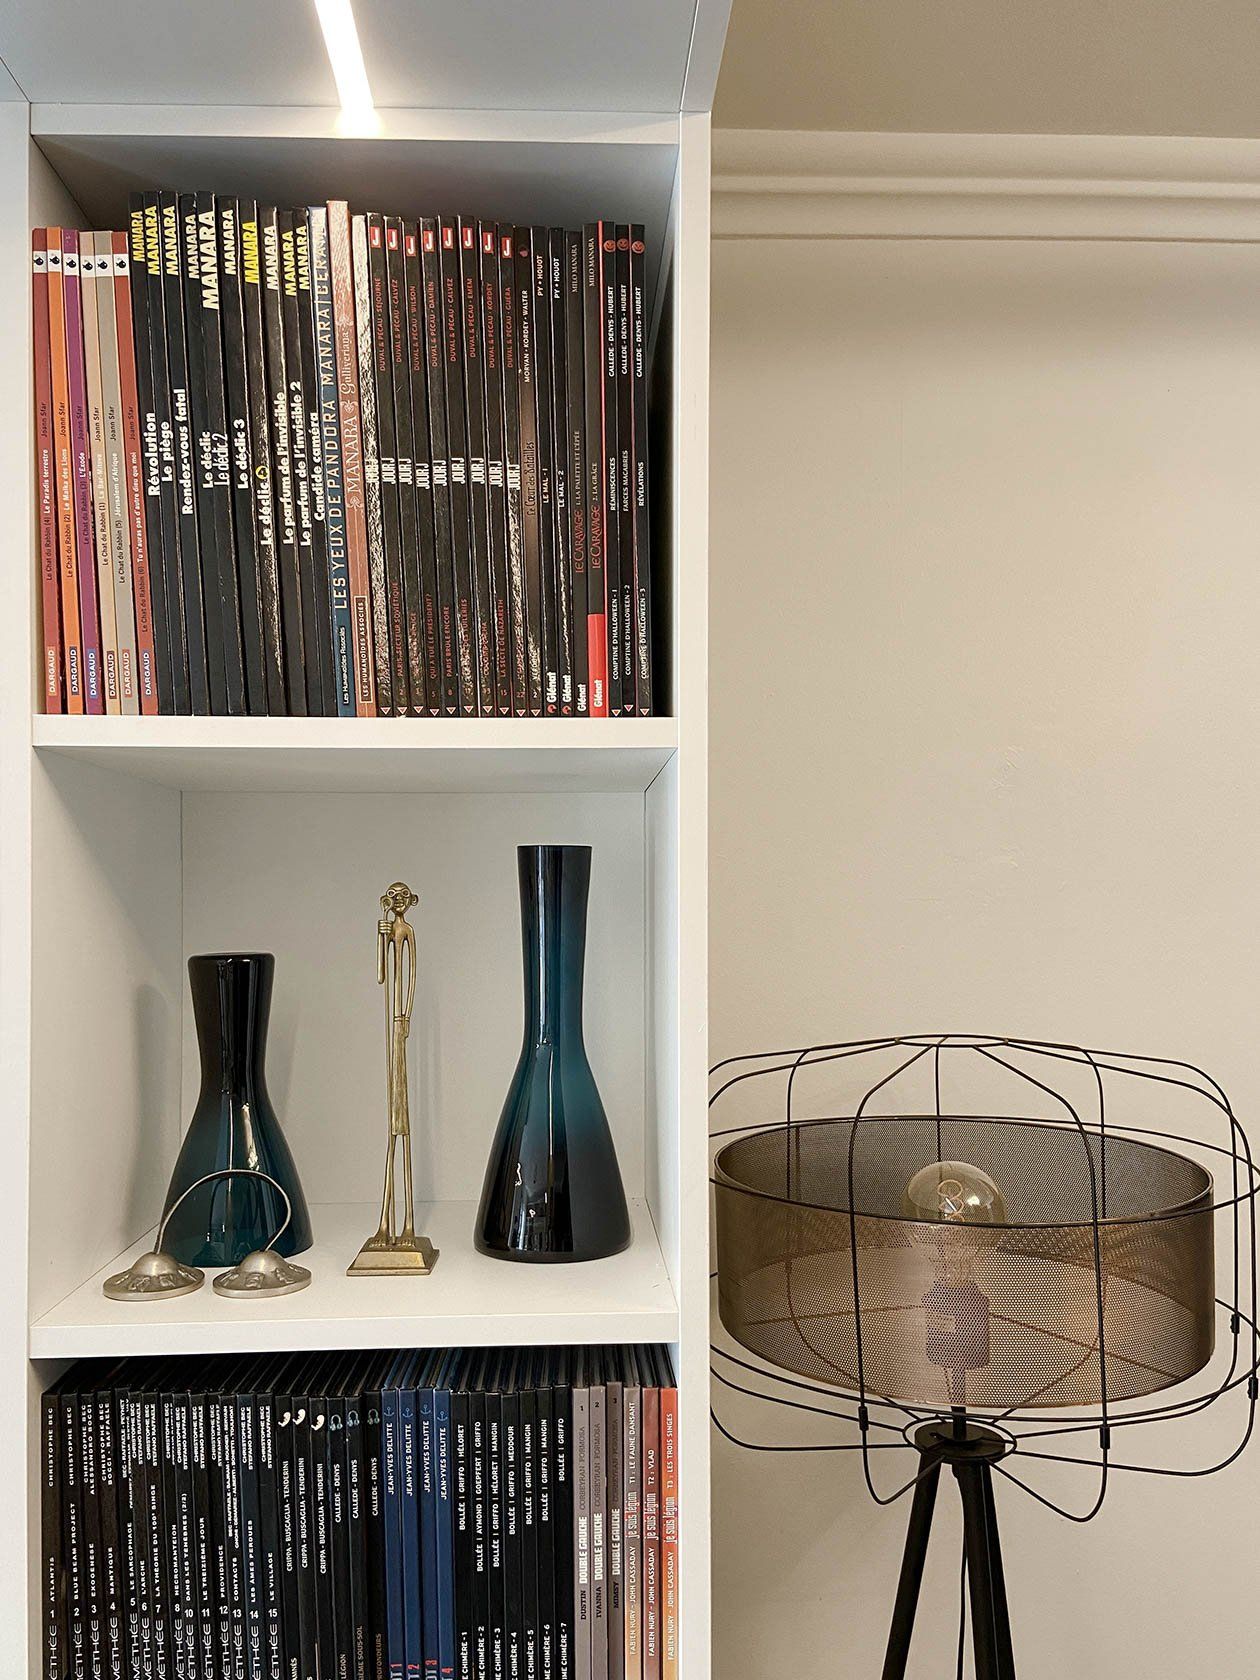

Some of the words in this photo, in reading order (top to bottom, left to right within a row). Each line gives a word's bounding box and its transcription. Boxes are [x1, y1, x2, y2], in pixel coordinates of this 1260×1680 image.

[131, 211, 145, 261] MANARA
[145, 206, 160, 275] MANARA
[163, 206, 178, 275] MANARA
[222, 210, 236, 274] MANARA
[242, 221, 259, 283] MANARA
[199, 211, 219, 310] MANARA
[282, 230, 297, 296] MANARA
[296, 226, 310, 290] MANARA
[587, 238, 595, 267] MANARA
[537, 287, 543, 296] PY
[318, 308, 334, 385] MANARA
[607, 346, 615, 377] CALLEDE
[290, 381, 301, 390] 2
[174, 389, 187, 421] fatal
[40, 418, 48, 437] Joann
[234, 419, 244, 429] 3
[292, 395, 306, 458] l'invisible
[308, 412, 321, 464] caméra
[144, 413, 160, 495] Révolution
[160, 422, 174, 462] piège
[200, 432, 212, 470] déclic
[213, 442, 228, 471] déclic
[234, 432, 248, 470] déclic
[323, 400, 340, 488] PANDORA
[343, 416, 361, 493] MANARA
[524, 442, 534, 474] Batailles
[178, 426, 194, 514] Rendez-vous
[295, 460, 306, 477] de
[381, 465, 395, 484] JOUR
[417, 470, 430, 489] JOUR
[452, 465, 465, 484] JOUR
[489, 468, 503, 487] JOUR
[527, 476, 535, 486] des
[297, 480, 312, 528] parfum
[312, 465, 325, 521] Candide
[329, 496, 341, 517] DE
[591, 505, 601, 557] CARAVAGE
[330, 525, 344, 570] YEUX
[333, 578, 347, 609] LES
[357, 602, 365, 635] ASSOCIÉS
[70, 650, 78, 692] DARGAUD
[547, 672, 557, 703] Glénat
[577, 684, 587, 711] Glénat
[593, 680, 603, 707] Glénat
[439, 1459, 447, 1500] JEAN-YVES
[626, 1492, 639, 1513] légion
[283, 1504, 292, 1541] BUSCAGLIA
[578, 1517, 587, 1549] GAUCHE
[593, 1513, 603, 1546] GAUCHE
[626, 1515, 637, 1528] suis
[626, 1530, 640, 1539] je
[492, 1540, 500, 1567] BOLLÉE
[579, 1552, 587, 1584] DOUBLE
[594, 1548, 603, 1580] DOUBLE
[647, 1548, 655, 1584] CASSADAY
[647, 1587, 655, 1604] JOHN
[647, 1611, 655, 1629] NURY
